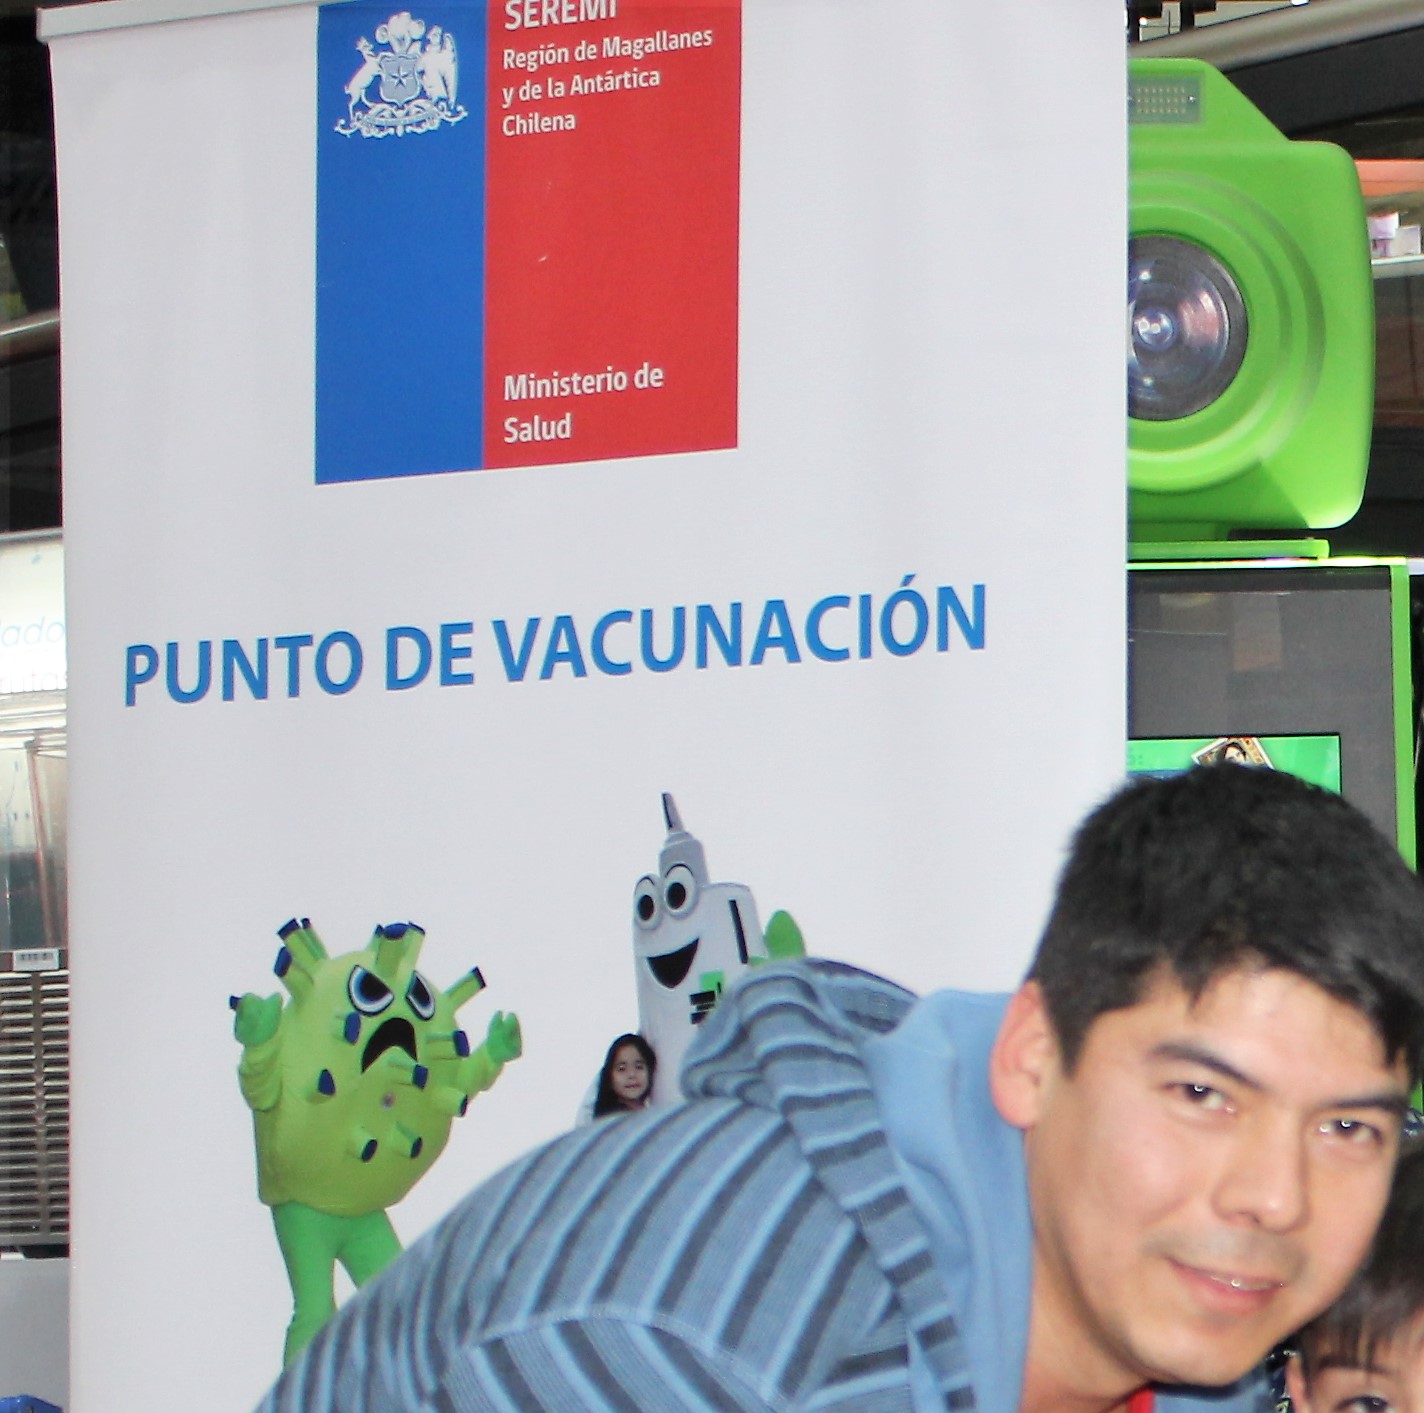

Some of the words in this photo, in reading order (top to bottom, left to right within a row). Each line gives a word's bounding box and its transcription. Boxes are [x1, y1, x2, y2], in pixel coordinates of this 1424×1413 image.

[502, 43, 570, 72] Región
[574, 40, 598, 62] de
[602, 28, 714, 60] Magallanes
[501, 86, 515, 109] y
[518, 80, 543, 102] de
[547, 77, 566, 99] la
[569, 68, 661, 96] Antártica
[502, 111, 577, 137] Chilena
[503, 366, 629, 401] Ministerio
[634, 362, 665, 389] de
[503, 412, 573, 443] Salud
[124, 628, 364, 707] PUNTO
[384, 620, 476, 691] DE
[492, 573, 988, 683] VACUNACIÓN
